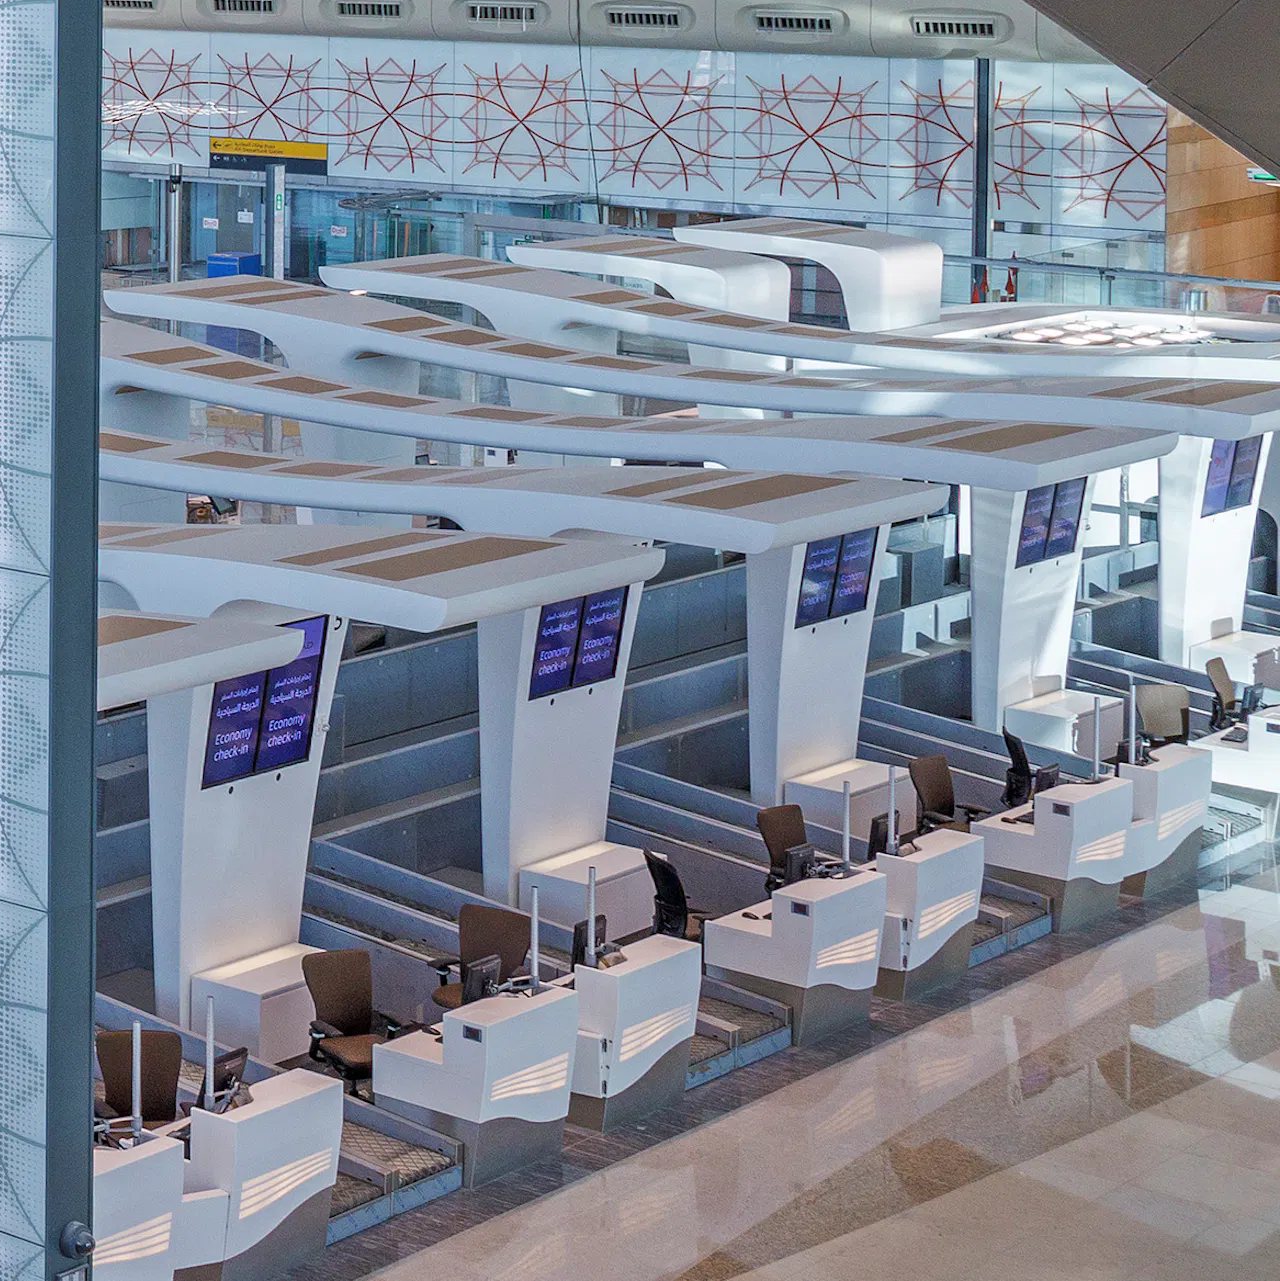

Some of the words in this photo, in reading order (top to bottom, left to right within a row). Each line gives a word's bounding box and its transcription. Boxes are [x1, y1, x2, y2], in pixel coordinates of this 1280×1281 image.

[584, 635, 614, 650] Economy
[540, 646, 571, 661] Economy
[582, 650, 611, 665] check-in
[538, 660, 568, 676] check-in
[268, 713, 306, 732] Economy
[214, 727, 253, 746] Economy
[267, 729, 302, 748] check-in
[213, 743, 249, 762] check-in
